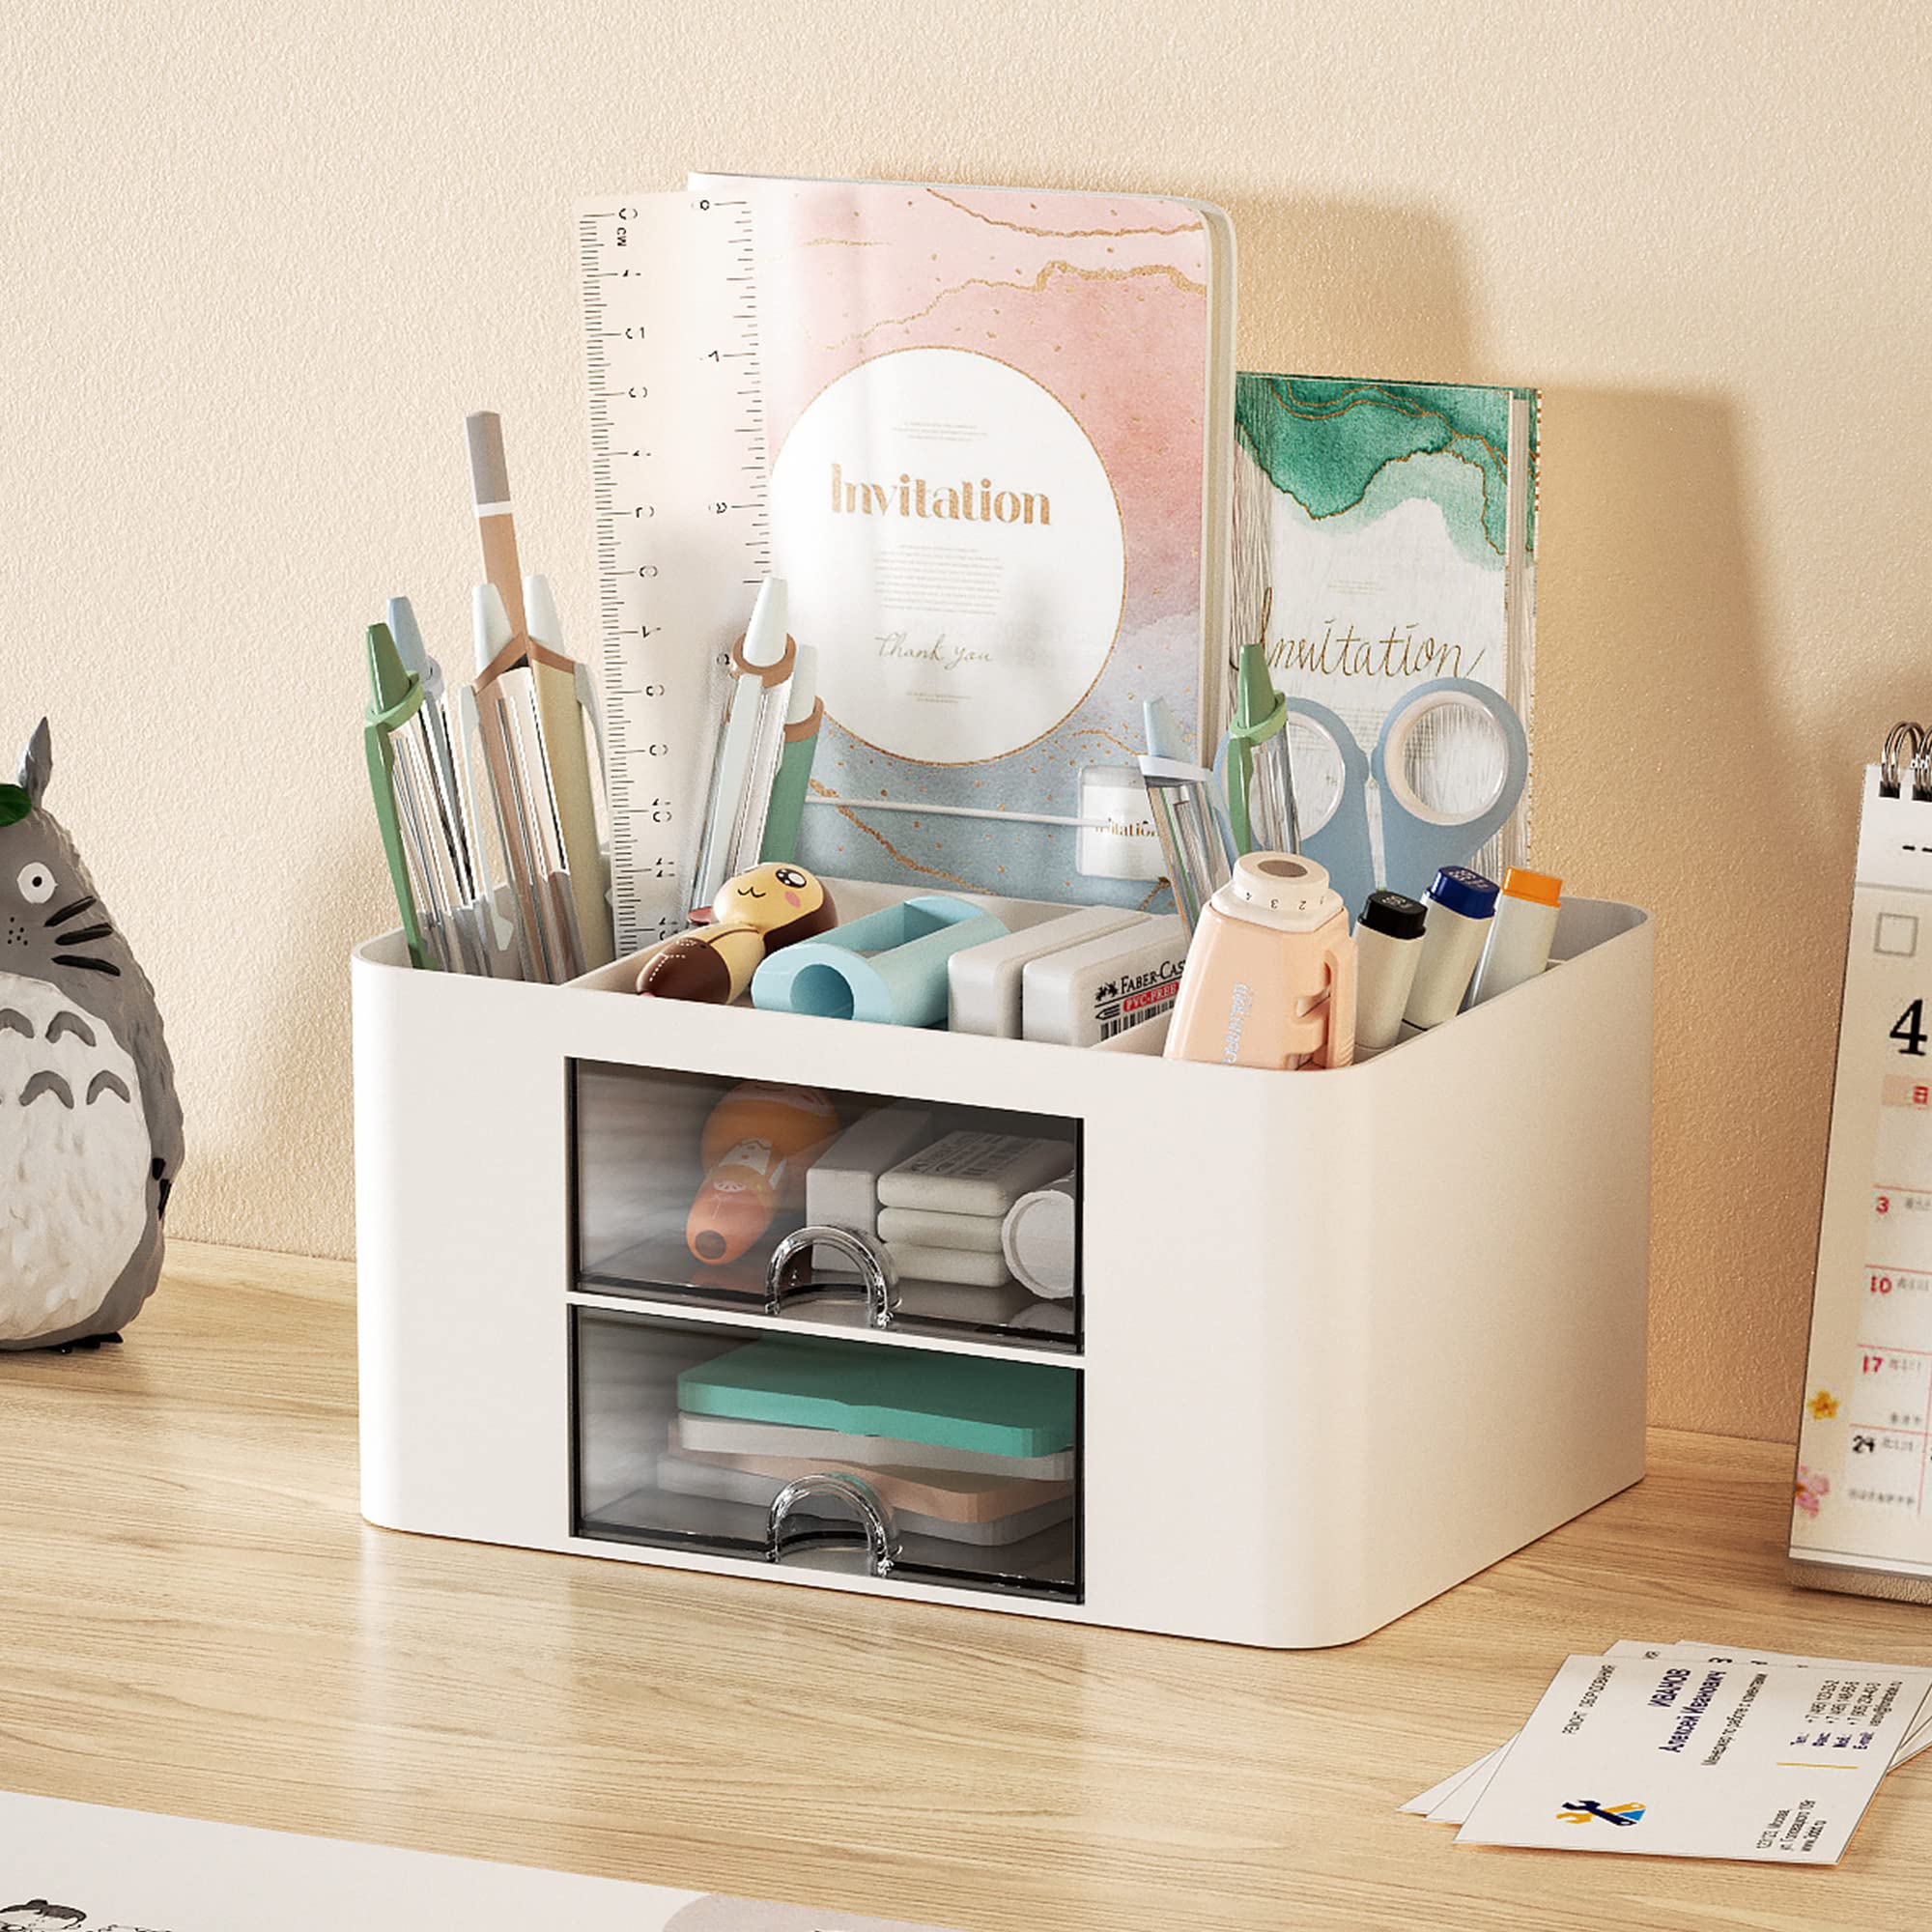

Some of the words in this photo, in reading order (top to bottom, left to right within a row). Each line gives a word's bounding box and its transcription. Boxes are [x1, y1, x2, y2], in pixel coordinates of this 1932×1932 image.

[831, 463, 1052, 526] Invitation
[1270, 898, 1280, 909] 3
[1121, 958, 1186, 994] FABER-CAS
[1889, 999, 1928, 1056] 4
[1876, 1196, 1889, 1214] 3
[1870, 1276, 1892, 1293] 10
[1862, 1355, 1884, 1373] 17
[1853, 1435, 1875, 1453] 24
[1647, 1668, 1691, 1707] ИВАНОВ
[1659, 1715, 1701, 1752] Алексей
[1680, 1670, 1727, 1715] Иванович
